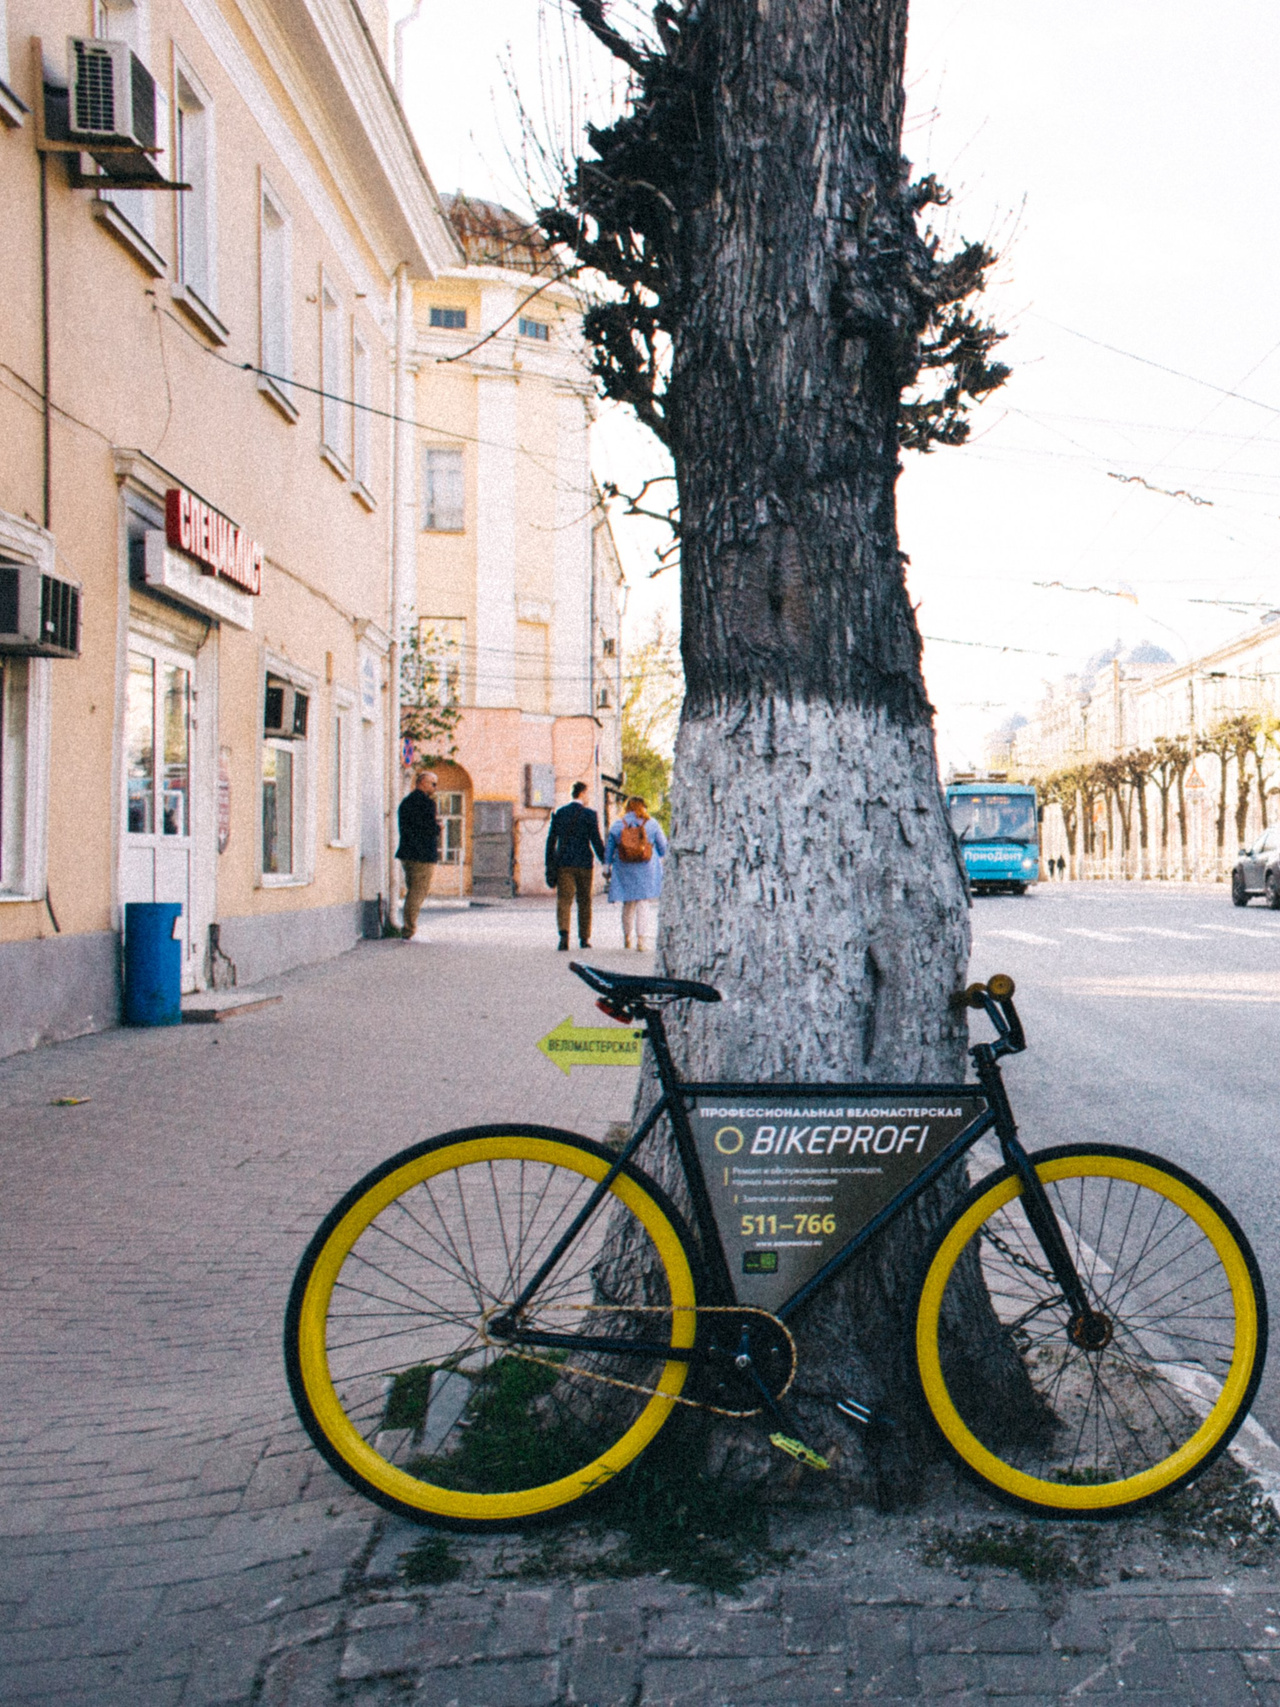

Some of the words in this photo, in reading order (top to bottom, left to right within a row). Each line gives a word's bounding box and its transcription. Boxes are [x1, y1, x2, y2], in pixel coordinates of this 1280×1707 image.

[547, 1039, 639, 1053] ВЕЛОМАСТЕРСКАЯ
[700, 1107, 844, 1118] ПРОФЕССИОНАЛЬНАЯ
[847, 1107, 963, 1118] ВЕЛОМАСТЕРСКАЯ
[750, 1125, 929, 1154] BIKEPROFI
[740, 1214, 837, 1236] 511-766
